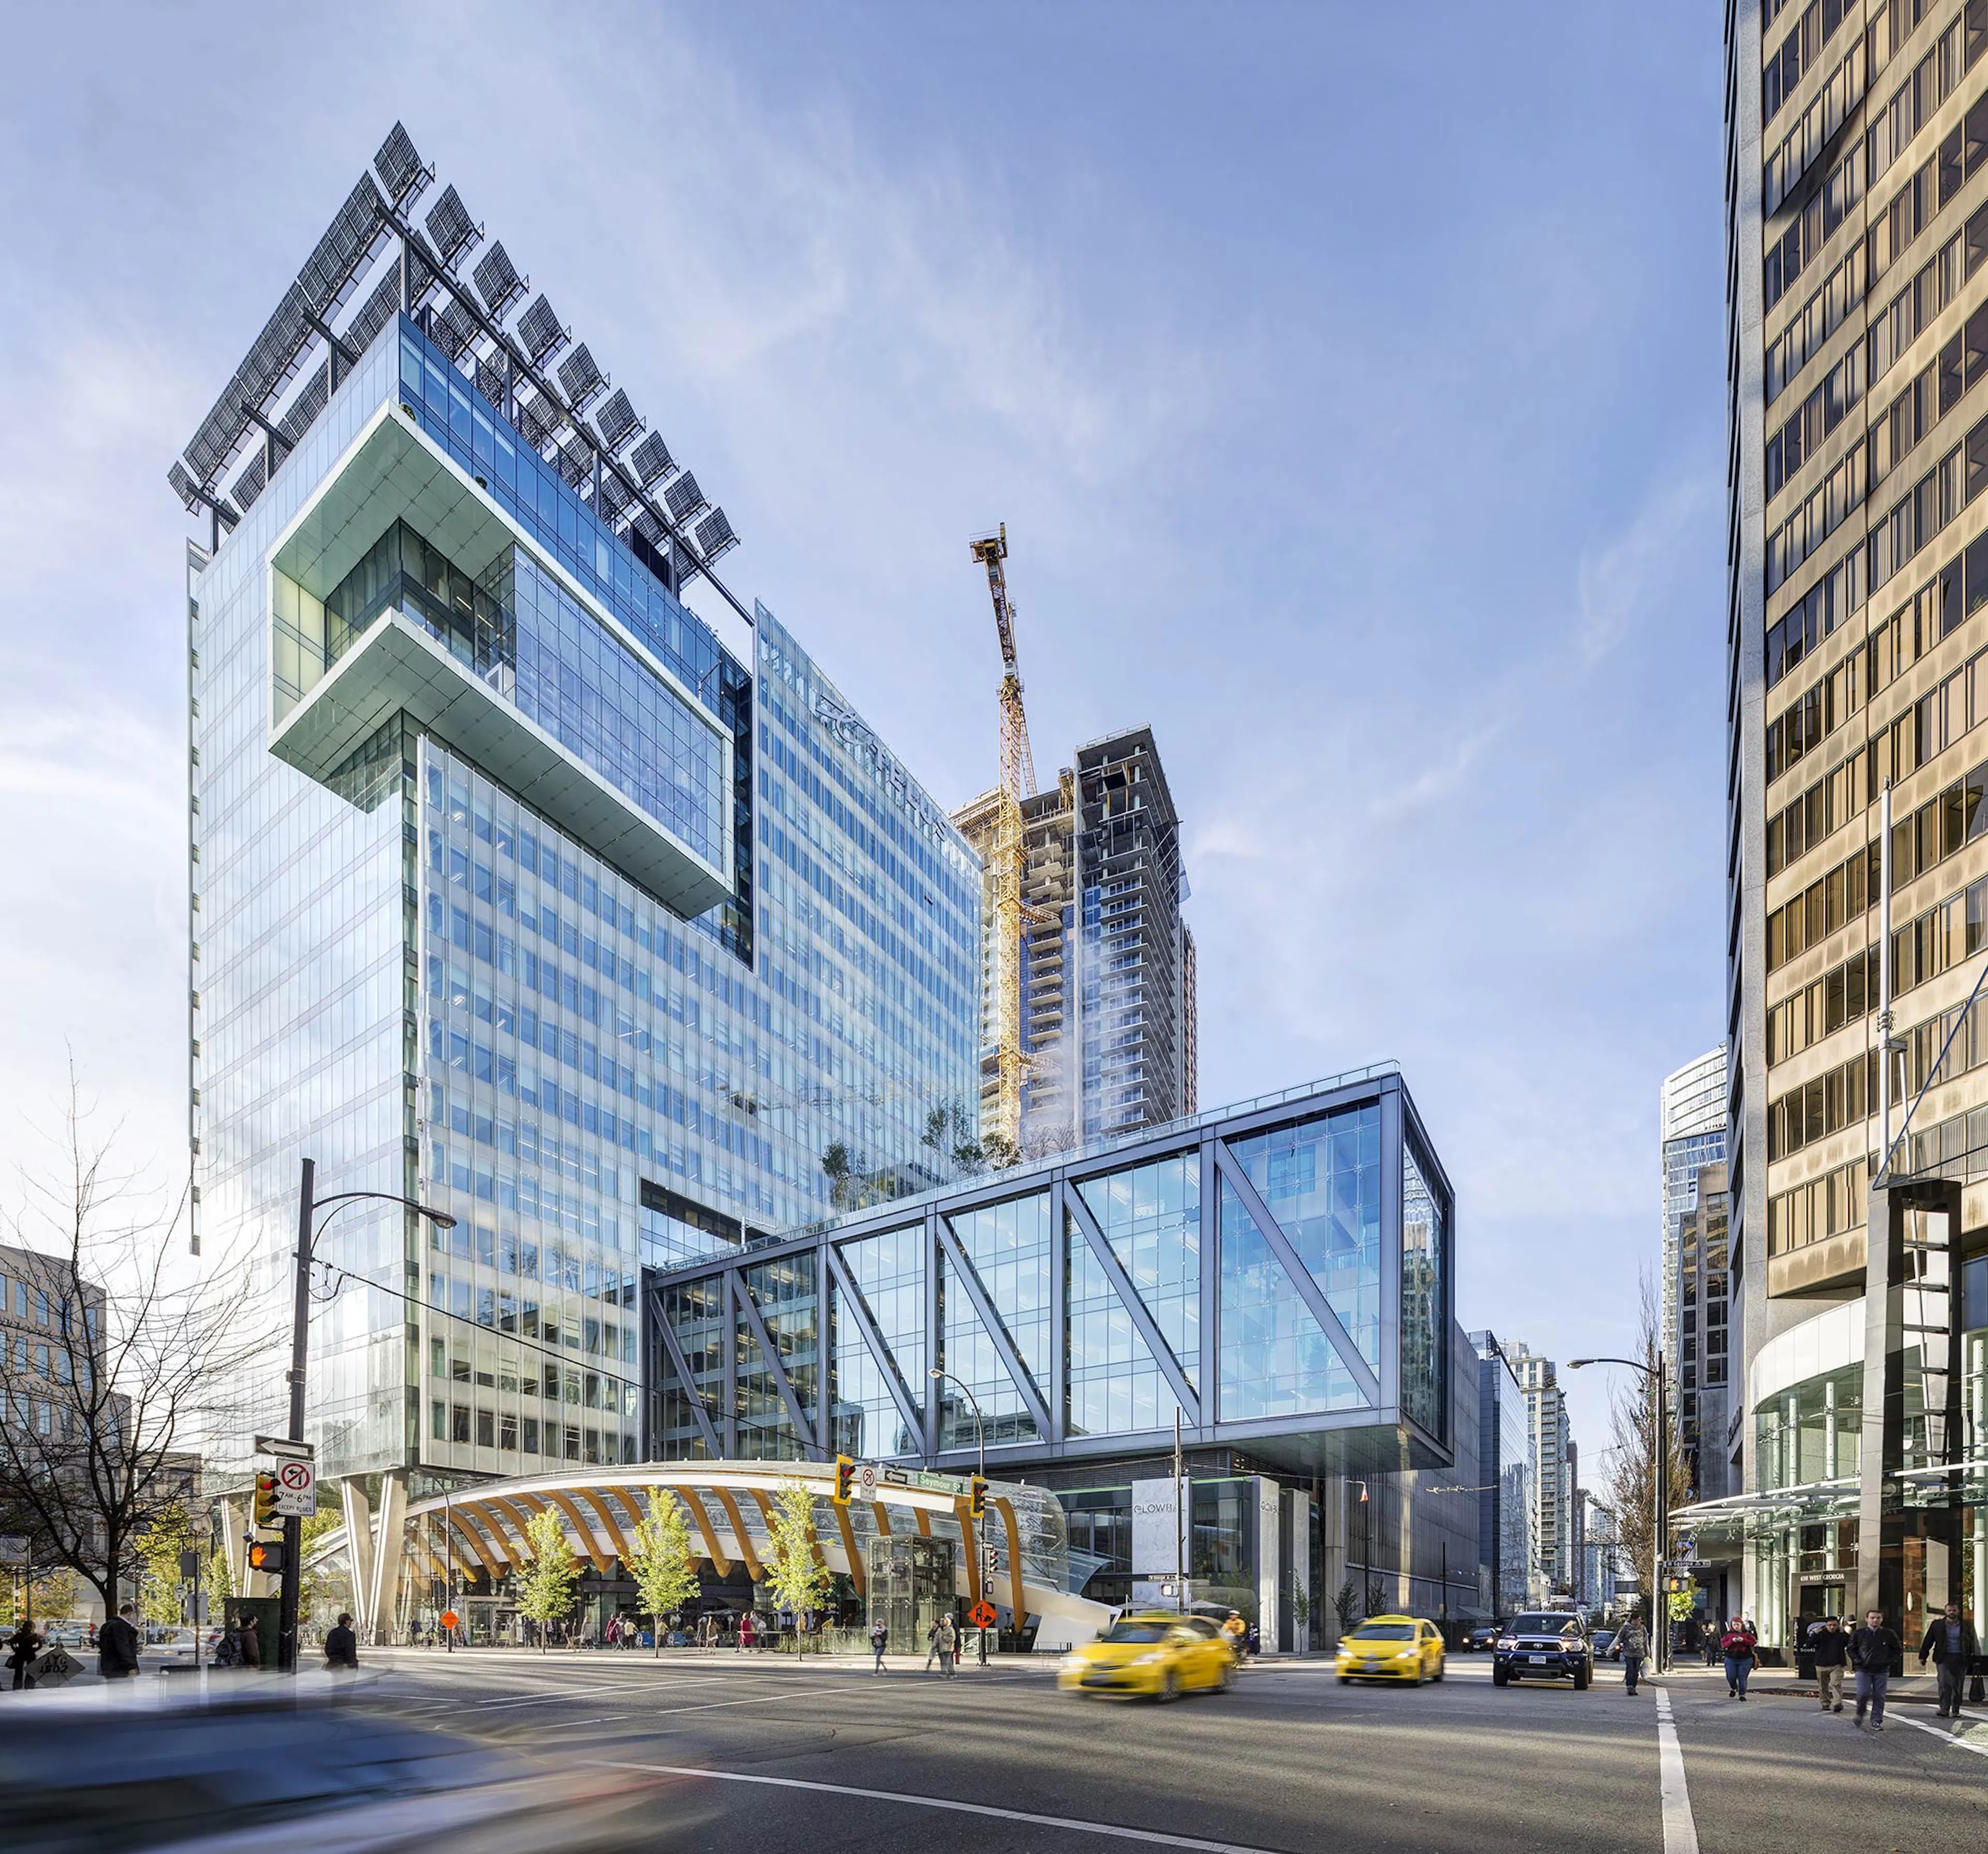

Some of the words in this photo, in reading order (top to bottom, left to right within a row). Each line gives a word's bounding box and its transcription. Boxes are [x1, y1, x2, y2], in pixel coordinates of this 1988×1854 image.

[920, 1475, 950, 1489] Seymour
[953, 1482, 961, 1492] St
[1134, 1503, 1185, 1513] GLOWBA
